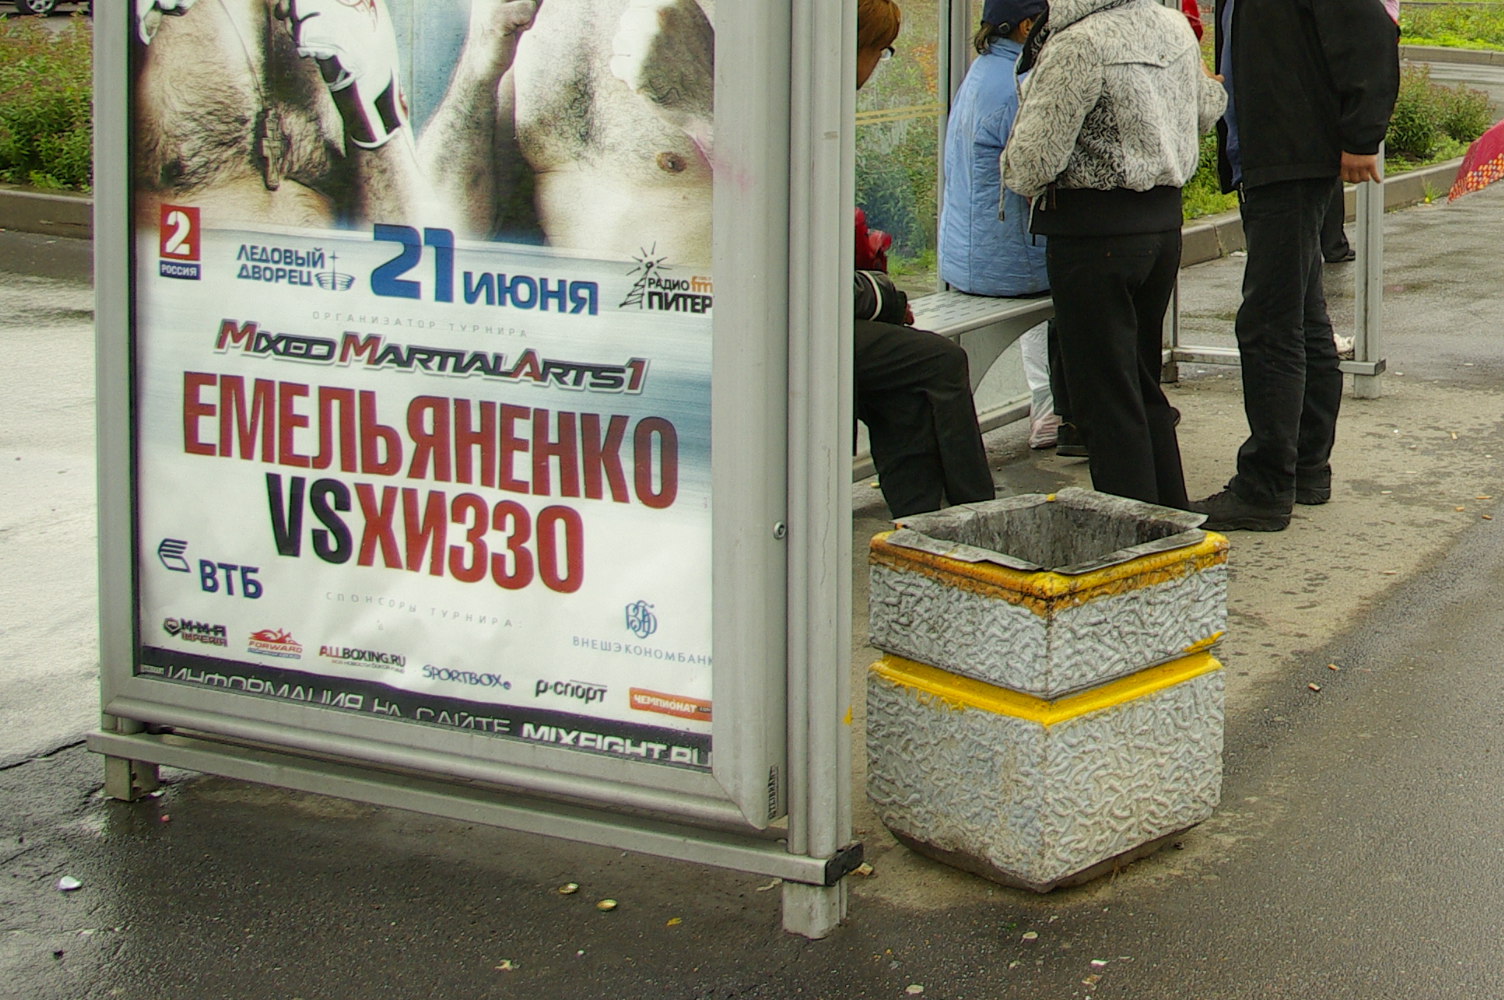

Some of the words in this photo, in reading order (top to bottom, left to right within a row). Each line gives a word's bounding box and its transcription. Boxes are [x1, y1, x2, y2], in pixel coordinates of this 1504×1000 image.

[164, 210, 191, 256] 2
[237, 244, 326, 269] ЛЕДОВЫЙ
[160, 263, 199, 278] РОССИЯ
[237, 264, 315, 288] ДВОРЕЦ
[370, 223, 456, 303] 21
[463, 270, 599, 316] ИЮНЯ
[647, 277, 690, 292] РАДИО
[647, 292, 713, 314] ПИТЕР
[312, 310, 437, 330] ОРГАНИЗАТОР
[449, 323, 528, 338] ТУРНИРА
[183, 370, 679, 510] ЕМЕЛЬЯНЕНКО
[198, 558, 264, 600] ВТБ
[325, 590, 417, 613] СПОНСОРЫ
[248, 640, 303, 654] FORWARD
[318, 645, 406, 668] ALLBOXING.RU
